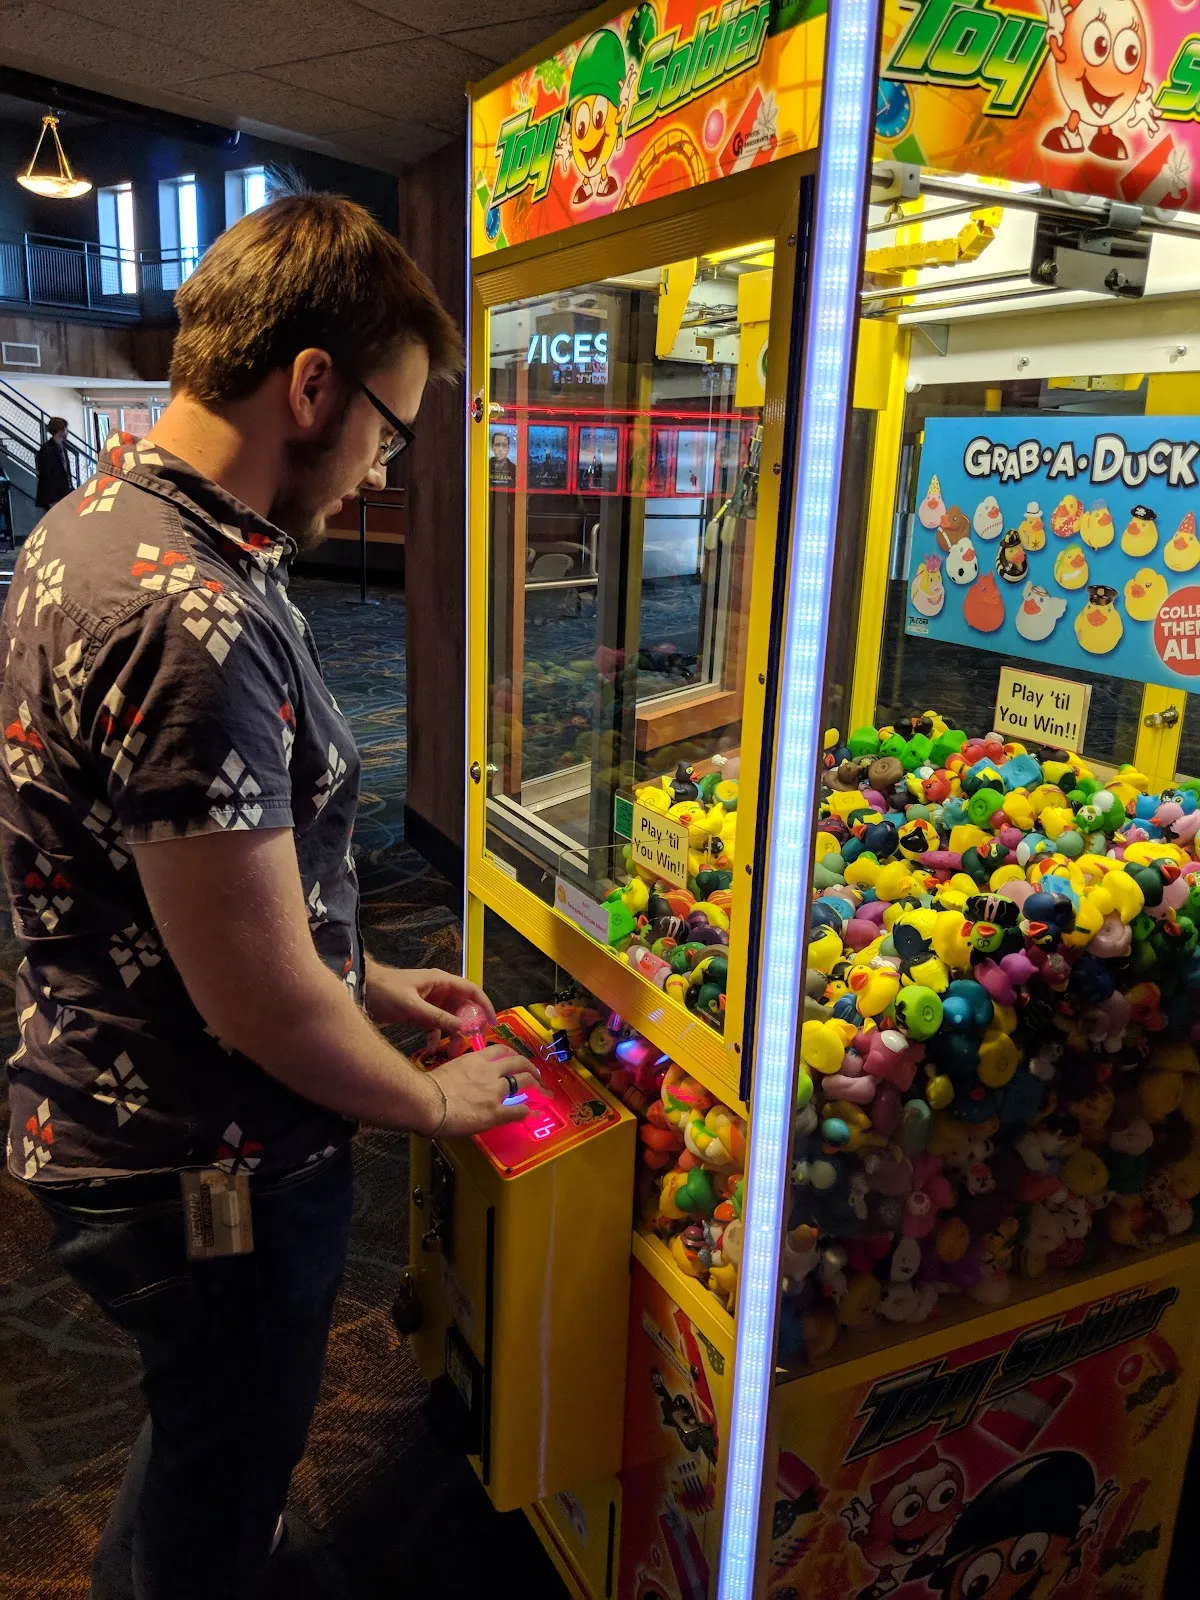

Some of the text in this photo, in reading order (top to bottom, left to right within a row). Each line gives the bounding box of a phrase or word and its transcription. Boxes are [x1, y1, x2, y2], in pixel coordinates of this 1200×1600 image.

[884, 0, 1050, 117] Toy
[491, 0, 769, 206] Toy Soldier
[1011, 682, 1044, 709] Play
[999, 706, 1077, 740] You Win!!
[641, 817, 663, 844] Play
[634, 837, 686, 879] You Win!!
[842, 1287, 1180, 1465] Toy Soldier
